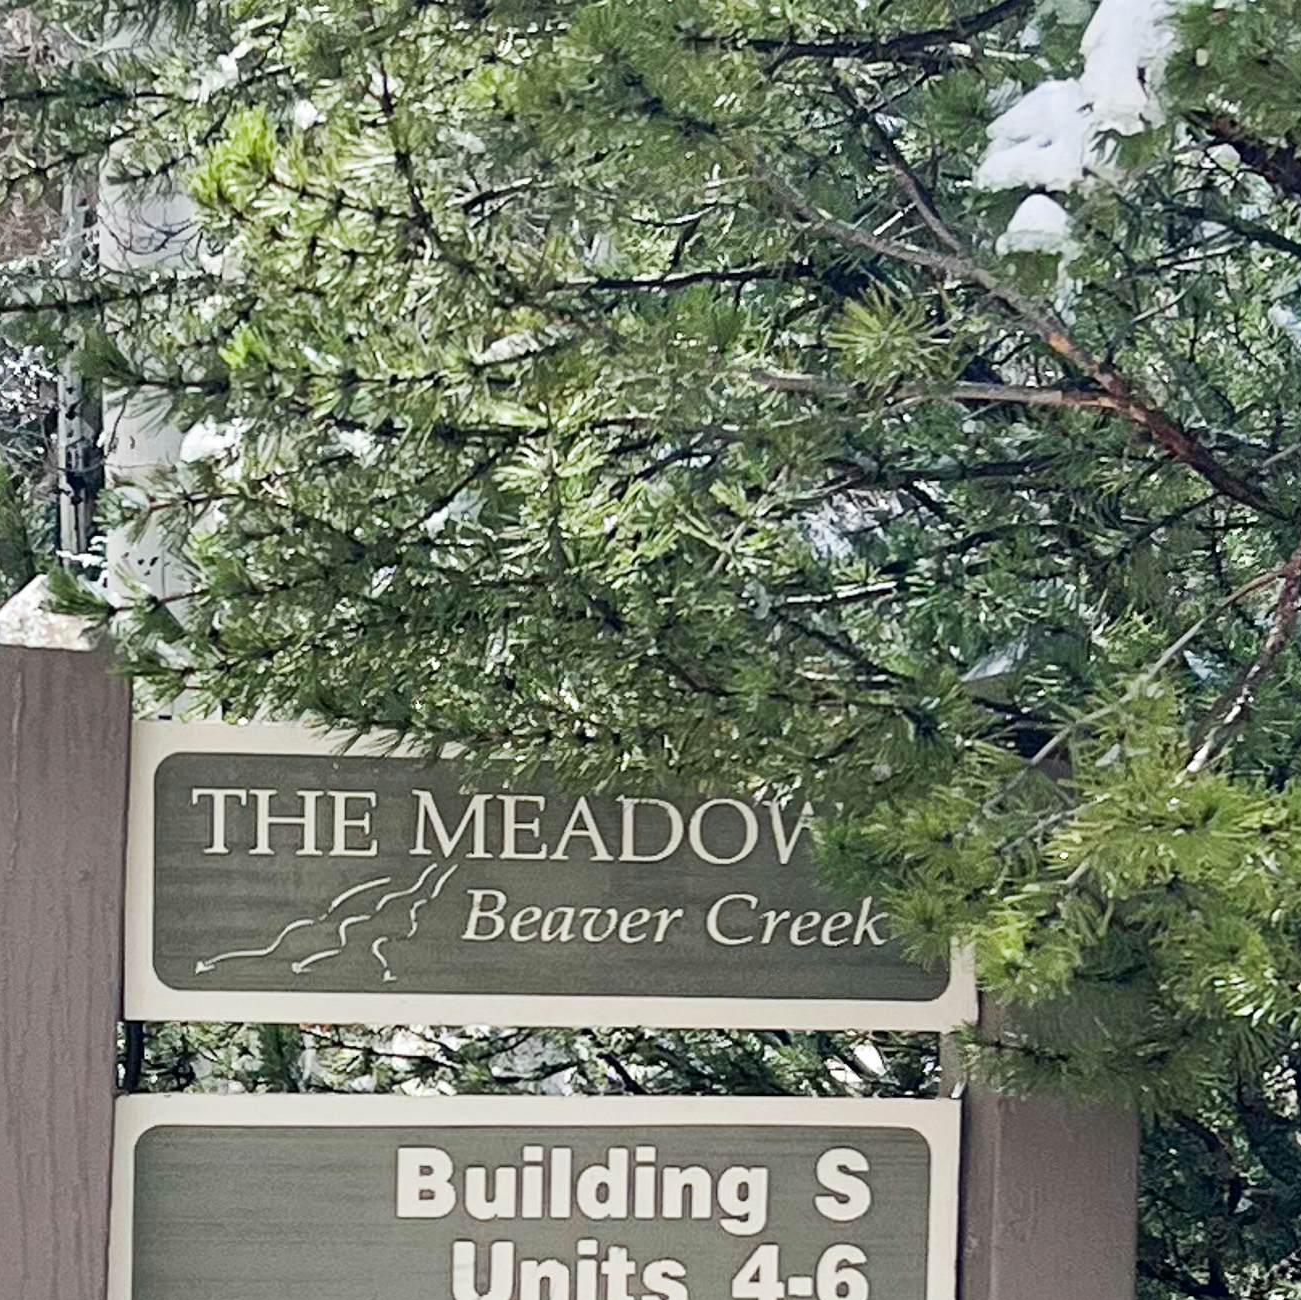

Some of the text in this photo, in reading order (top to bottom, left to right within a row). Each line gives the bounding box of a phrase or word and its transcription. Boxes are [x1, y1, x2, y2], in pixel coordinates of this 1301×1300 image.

[191, 787, 379, 857] THE
[461, 888, 889, 948] Beaver Creek
[395, 1145, 873, 1236] Building S
